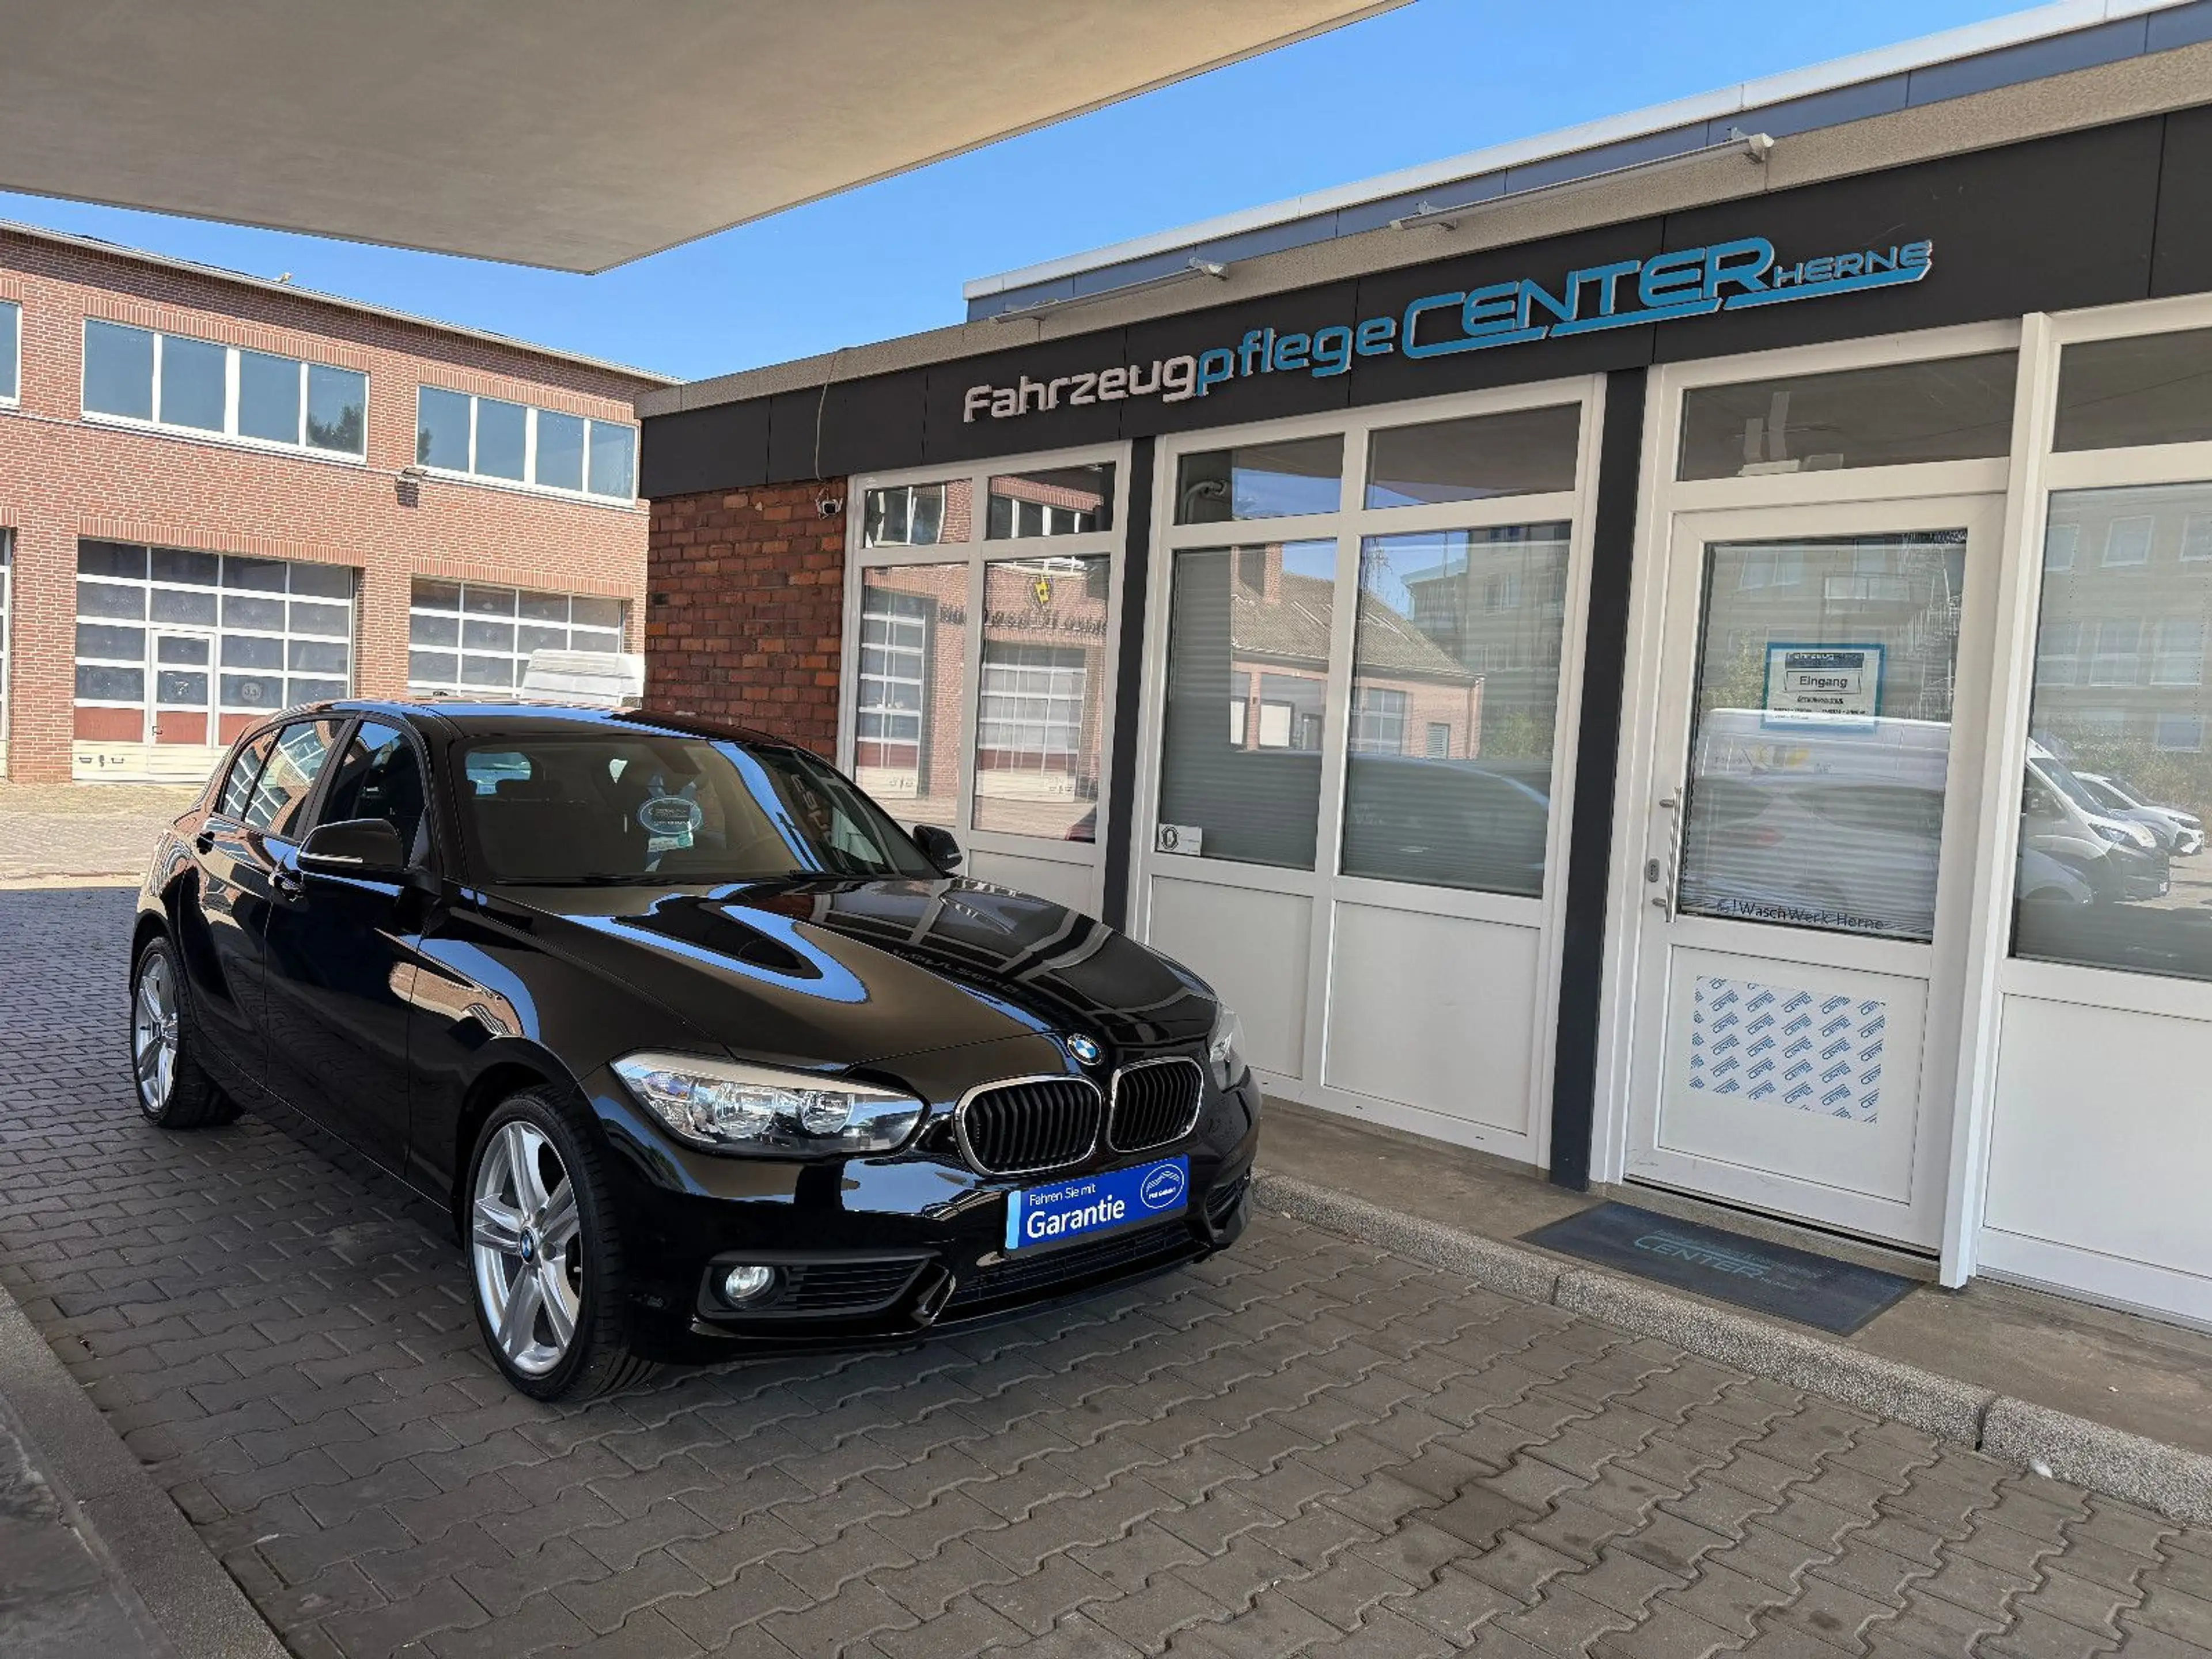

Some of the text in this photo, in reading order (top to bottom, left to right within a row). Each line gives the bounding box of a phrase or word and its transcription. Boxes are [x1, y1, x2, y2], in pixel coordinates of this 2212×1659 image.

[1772, 239, 1933, 287] HERNE
[1799, 676, 1848, 688] Eingang
[1029, 1183, 1096, 1206] Fahren Sie mit
[1027, 1194, 1126, 1238] Garantie
